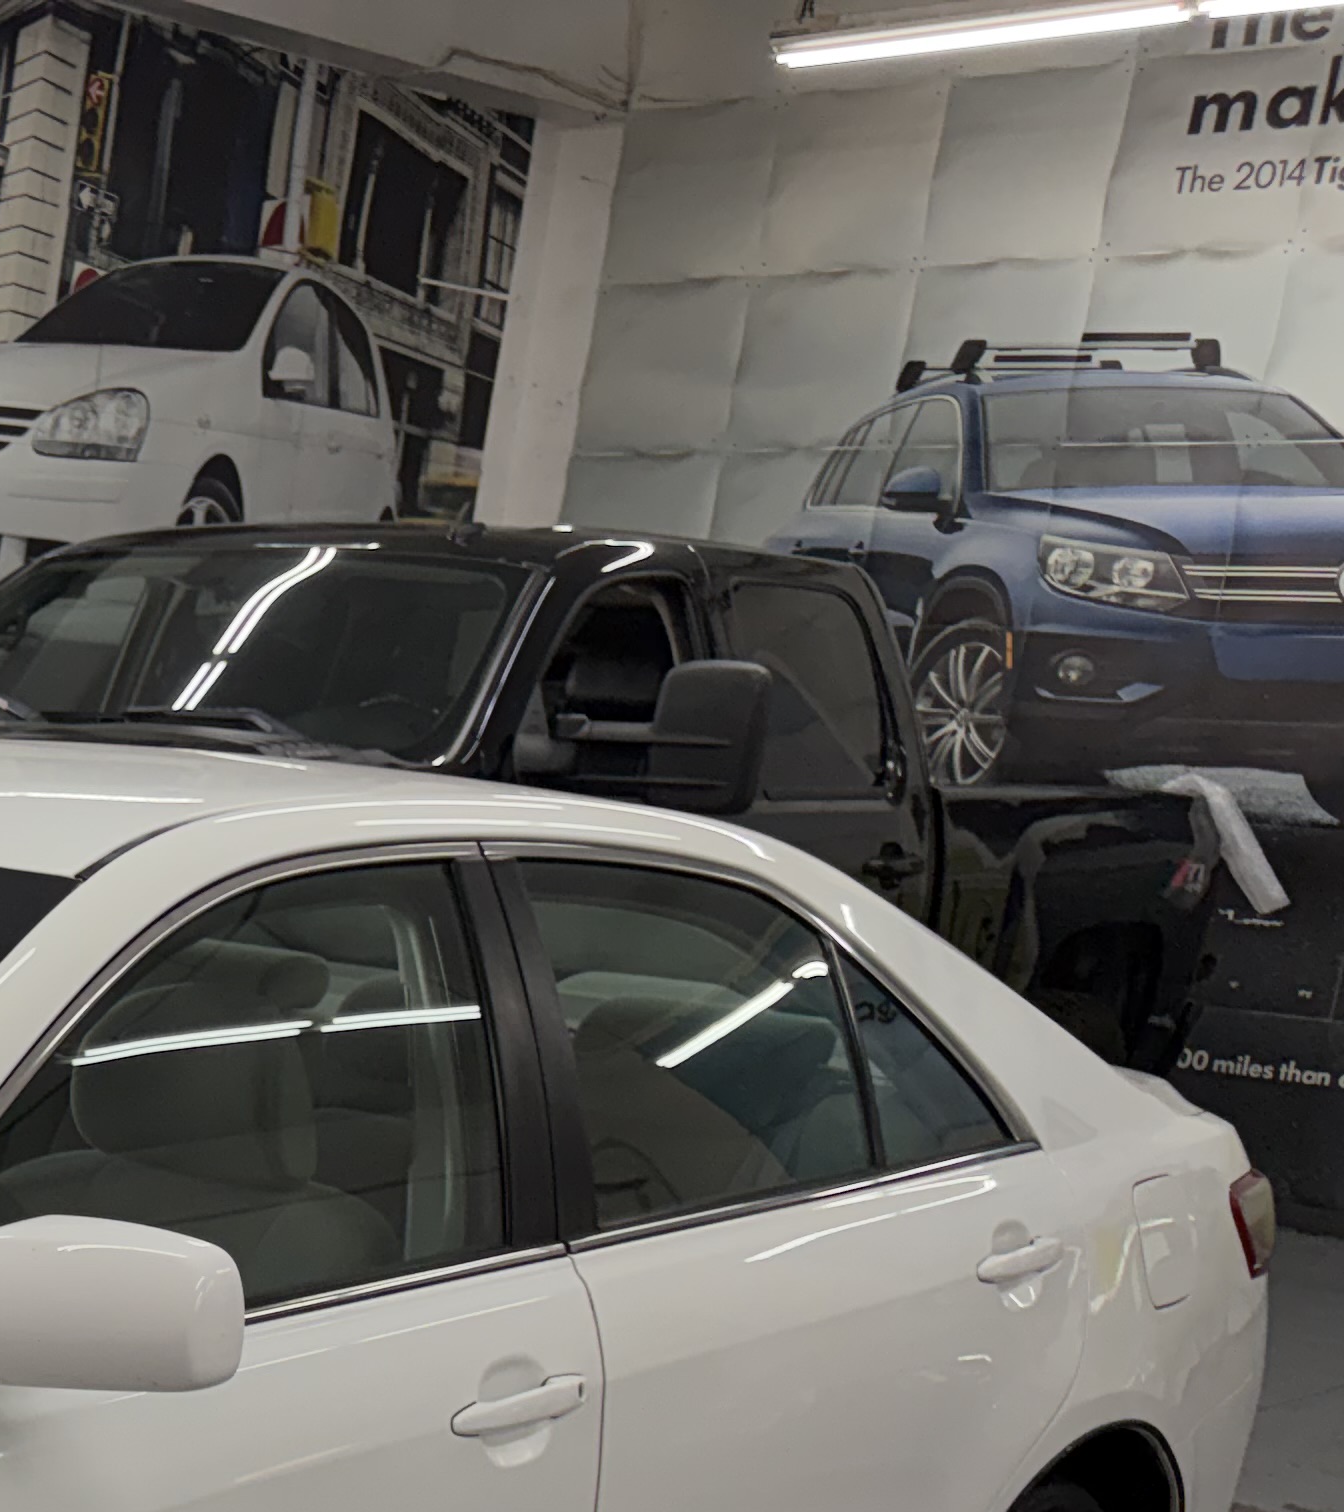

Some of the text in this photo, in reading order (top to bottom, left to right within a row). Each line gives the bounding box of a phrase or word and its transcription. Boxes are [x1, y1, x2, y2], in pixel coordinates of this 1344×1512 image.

[1175, 164, 1225, 195] The
[1233, 158, 1307, 191] 2014
[1213, 1055, 1274, 1080] miles
[1280, 1060, 1331, 1087] than
